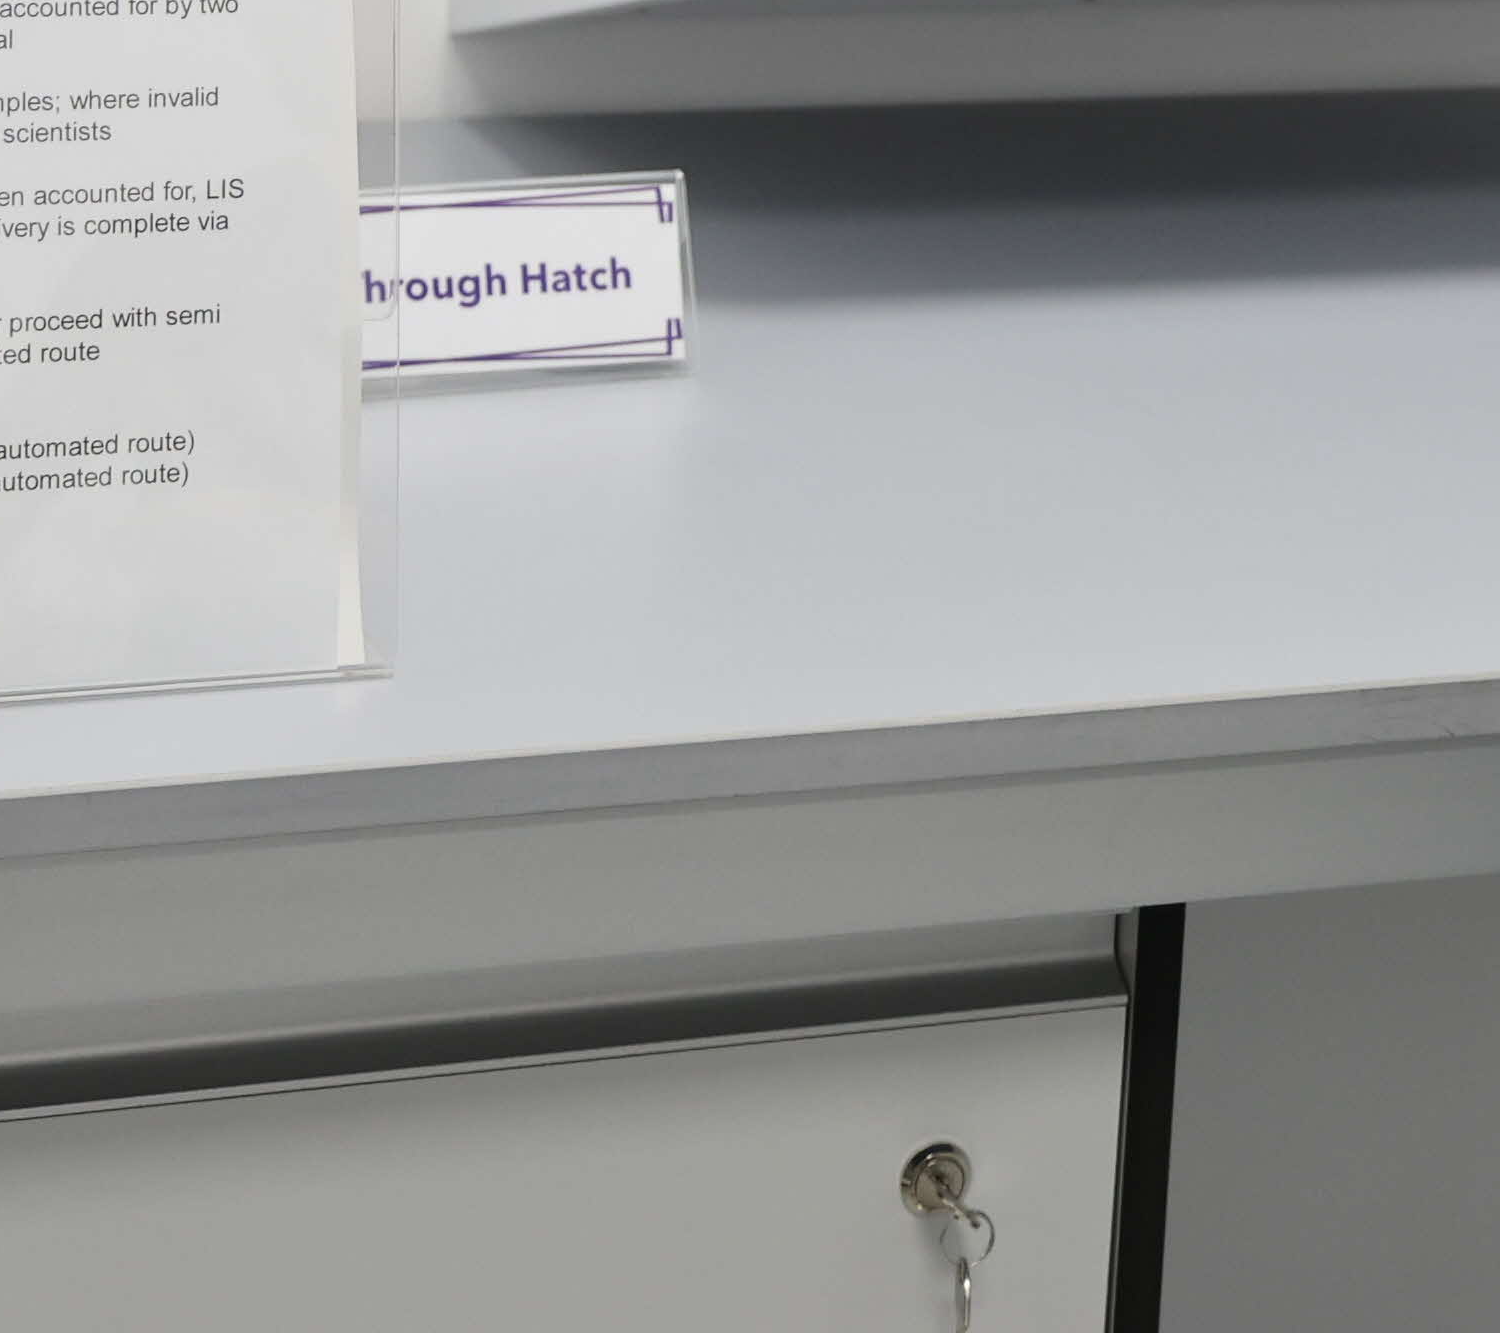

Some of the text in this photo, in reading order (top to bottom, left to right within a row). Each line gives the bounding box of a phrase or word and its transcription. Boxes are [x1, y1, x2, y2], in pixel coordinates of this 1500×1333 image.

[69, 88, 140, 110] where
[148, 86, 219, 109] invalid
[3, 121, 112, 144] scientists
[33, 181, 155, 206] accounted
[163, 180, 197, 204] for,
[206, 178, 245, 200] LIS
[57, 215, 76, 237] is
[83, 212, 191, 239] complete
[197, 209, 229, 232] via
[520, 256, 632, 295] Hatch
[9, 308, 103, 338] proceed
[112, 306, 157, 329] with
[165, 303, 221, 326] semi
[40, 341, 101, 364] route
[128, 429, 195, 456] route)
[121, 460, 189, 488] route)
